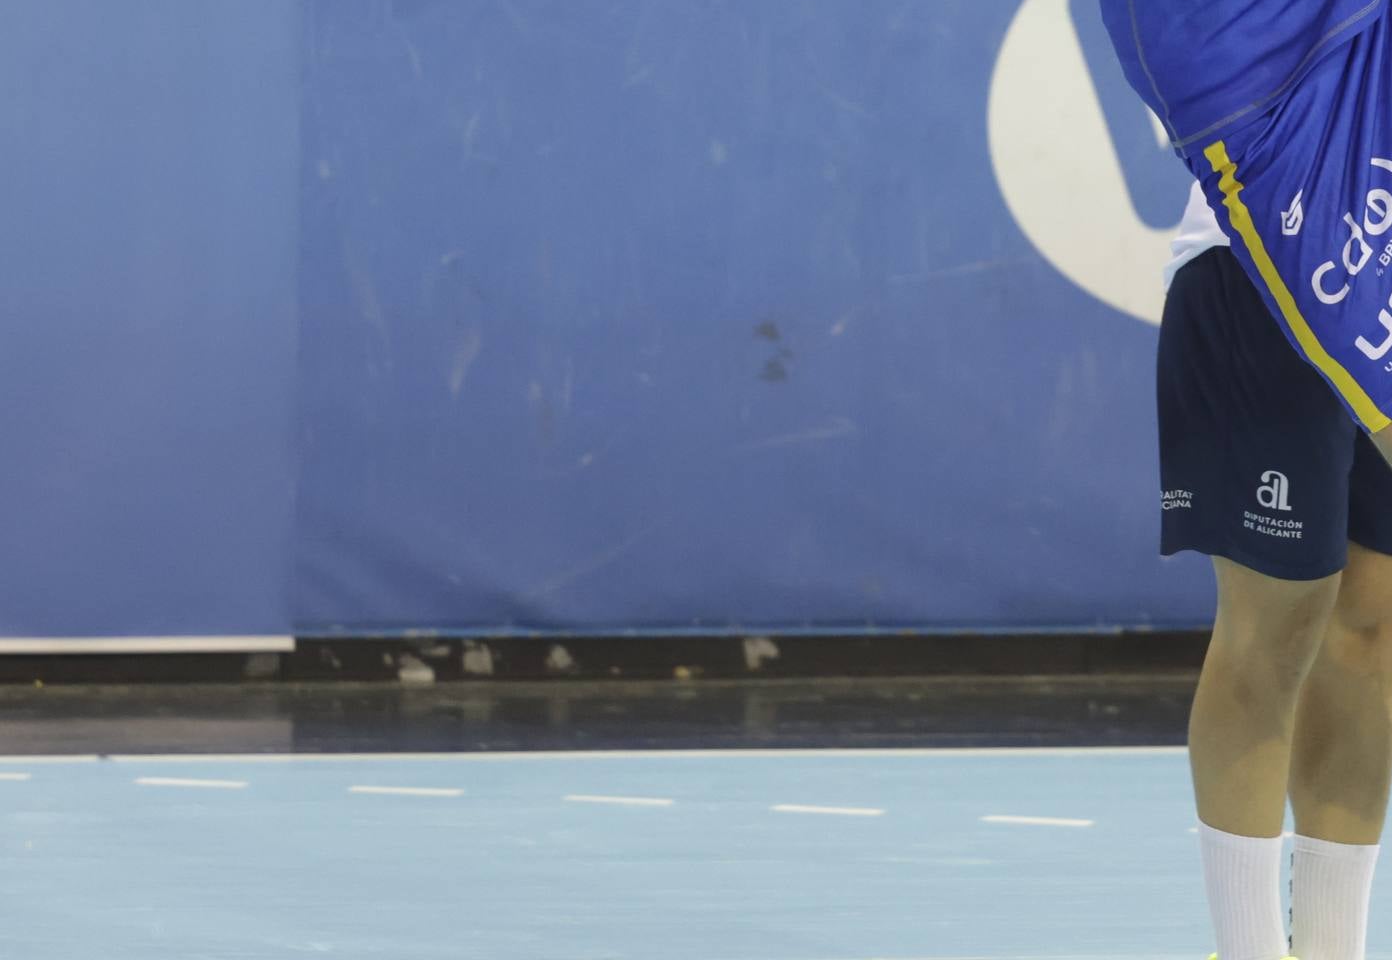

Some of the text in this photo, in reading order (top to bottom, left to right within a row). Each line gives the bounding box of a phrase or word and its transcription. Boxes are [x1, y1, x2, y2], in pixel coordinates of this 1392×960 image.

[1244, 510, 1303, 529] DIPUTACIÓN
[1243, 520, 1303, 539] DE ALICANTE
